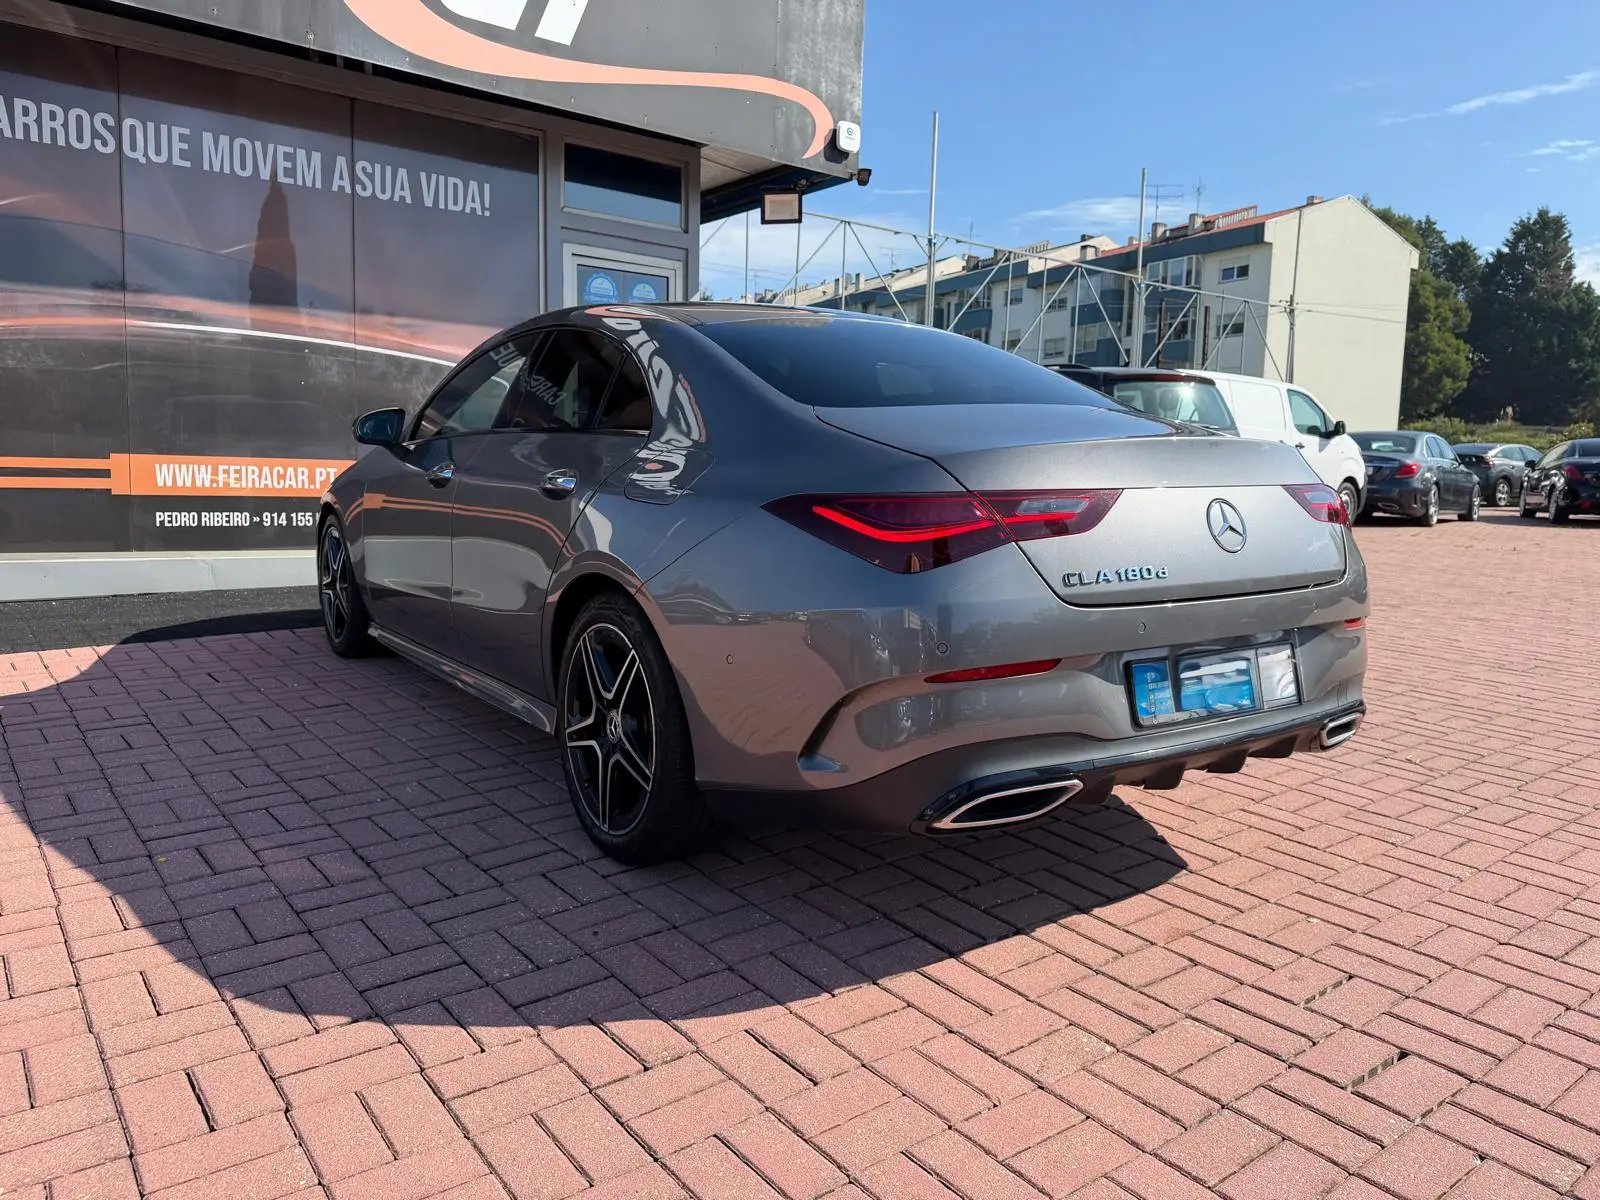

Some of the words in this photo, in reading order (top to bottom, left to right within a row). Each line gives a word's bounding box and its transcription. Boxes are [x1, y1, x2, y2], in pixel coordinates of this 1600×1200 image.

[121, 117, 192, 167] QUE
[202, 131, 322, 189] MOVEM
[332, 155, 352, 194] A
[355, 160, 412, 204] SUA
[420, 171, 490, 216] VIDA!
[154, 463, 338, 489] WWW.FEIRACAR.PT
[155, 511, 198, 527] PEDRO
[201, 511, 250, 527] RIBEIRO
[262, 511, 287, 527] 914
[290, 511, 313, 527] 155
